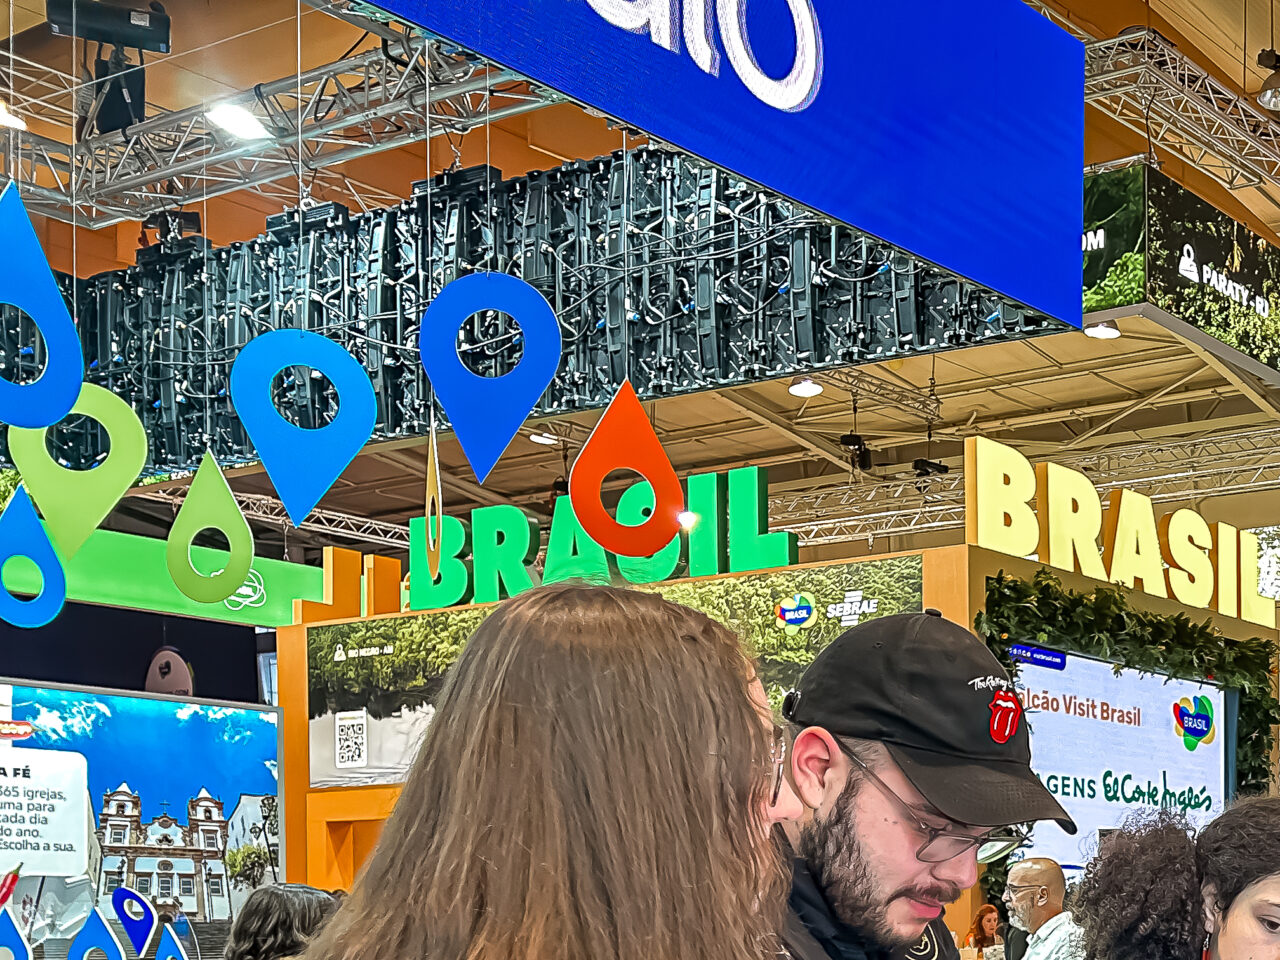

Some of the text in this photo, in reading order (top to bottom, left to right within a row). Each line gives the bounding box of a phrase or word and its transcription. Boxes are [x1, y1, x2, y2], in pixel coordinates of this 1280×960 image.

[1202, 264, 1250, 307] PARATY
[967, 435, 1276, 630] BRASIL
[826, 598, 879, 619] SEBRAE
[1062, 694, 1098, 720] Visit
[1100, 701, 1141, 727] Brasil
[1183, 716, 1208, 731] BRASIL
[13, 765, 31, 779] FÉ
[1035, 773, 1097, 799] GENS
[1102, 770, 1120, 803] El
[23, 787, 67, 802] igrejas,
[27, 802, 56, 813] para
[29, 813, 49, 825] dia
[16, 828, 42, 838] ano.
[43, 841, 51, 851] a
[53, 842, 77, 853] sua.
